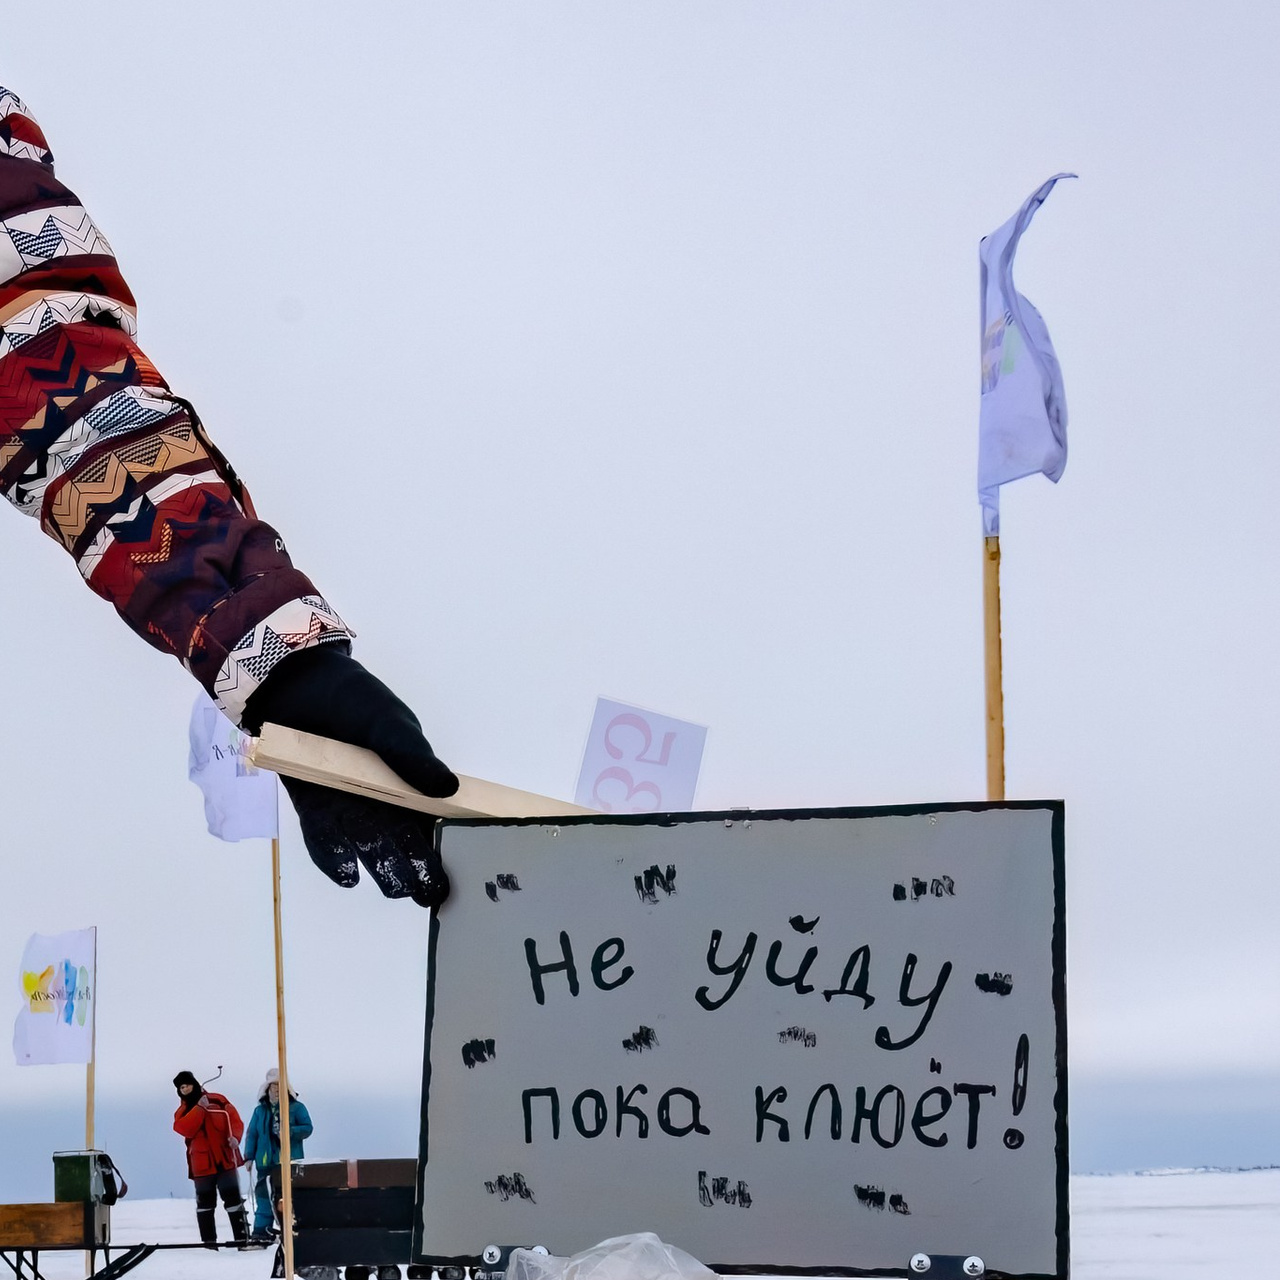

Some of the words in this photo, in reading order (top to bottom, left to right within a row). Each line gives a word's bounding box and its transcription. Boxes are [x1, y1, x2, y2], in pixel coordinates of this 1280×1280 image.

[523, 930, 635, 1006] Не
[694, 914, 953, 1051] уйду
[521, 1083, 711, 1144] пока
[754, 1033, 1030, 1151] клюёт!
